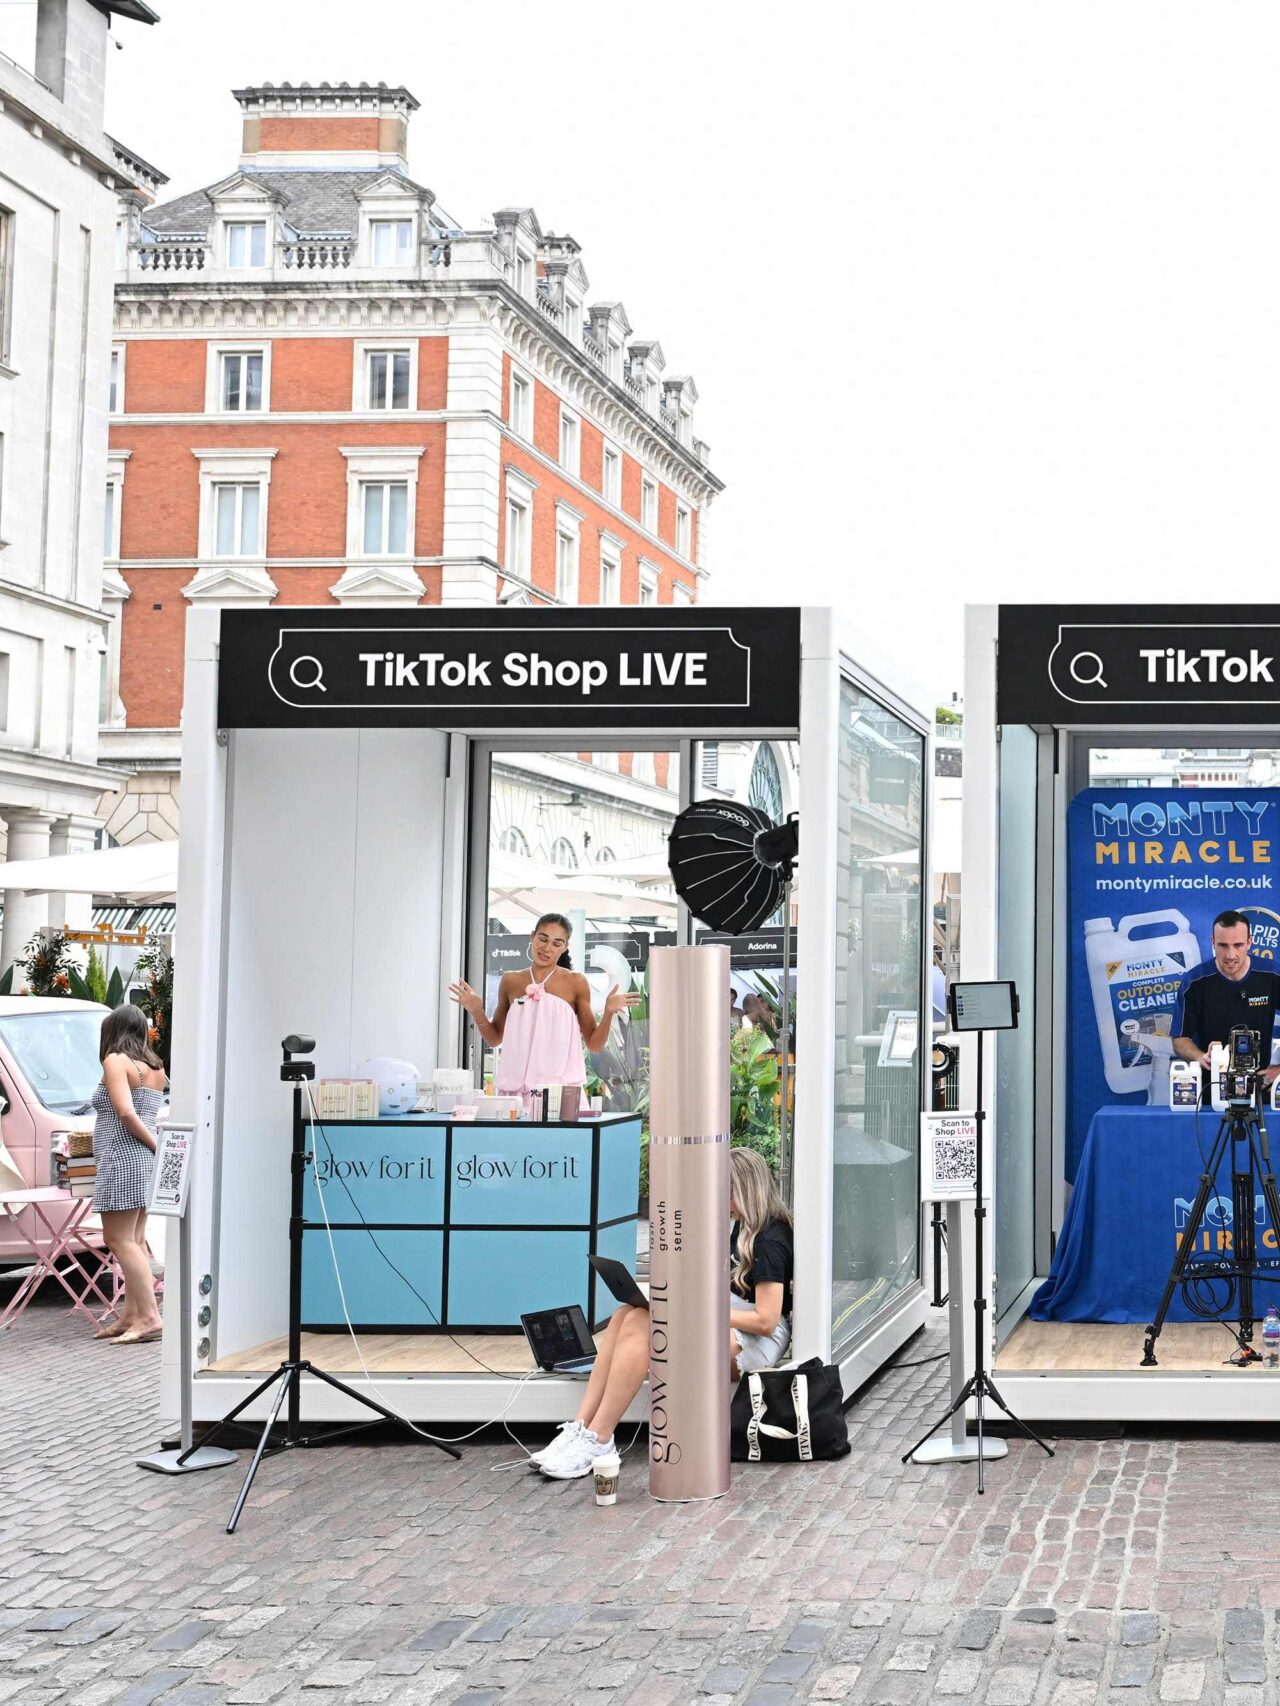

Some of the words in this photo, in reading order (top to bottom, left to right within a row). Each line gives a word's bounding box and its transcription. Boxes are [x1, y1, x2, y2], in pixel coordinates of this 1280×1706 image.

[359, 652, 492, 687] TikTok
[502, 652, 608, 694] Shop
[619, 653, 708, 686] LIVE
[1139, 648, 1274, 683] TikTok
[1092, 801, 1269, 836] MONTY
[1095, 840, 1271, 865] MIRACLE
[1096, 874, 1273, 893] montymiracle.co.uk
[1250, 924, 1279, 938] PID
[1252, 936, 1279, 948] ULTS
[500, 949, 521, 957] TikTok
[748, 942, 778, 951] Adorina
[1126, 959, 1164, 972] MONTY
[1118, 992, 1178, 1012] CLEANE
[935, 1127, 956, 1136] Shop
[957, 1127, 976, 1135] LIVE
[165, 1140, 176, 1149] Shop
[313, 1154, 374, 1189] glow
[379, 1155, 415, 1180] for
[420, 1156, 436, 1180] it
[456, 1154, 516, 1189] glow
[522, 1155, 559, 1179] for
[562, 1156, 581, 1179] it
[657, 1201, 669, 1251] growth
[673, 1209, 682, 1252] serum
[650, 1373, 682, 1465] glow
